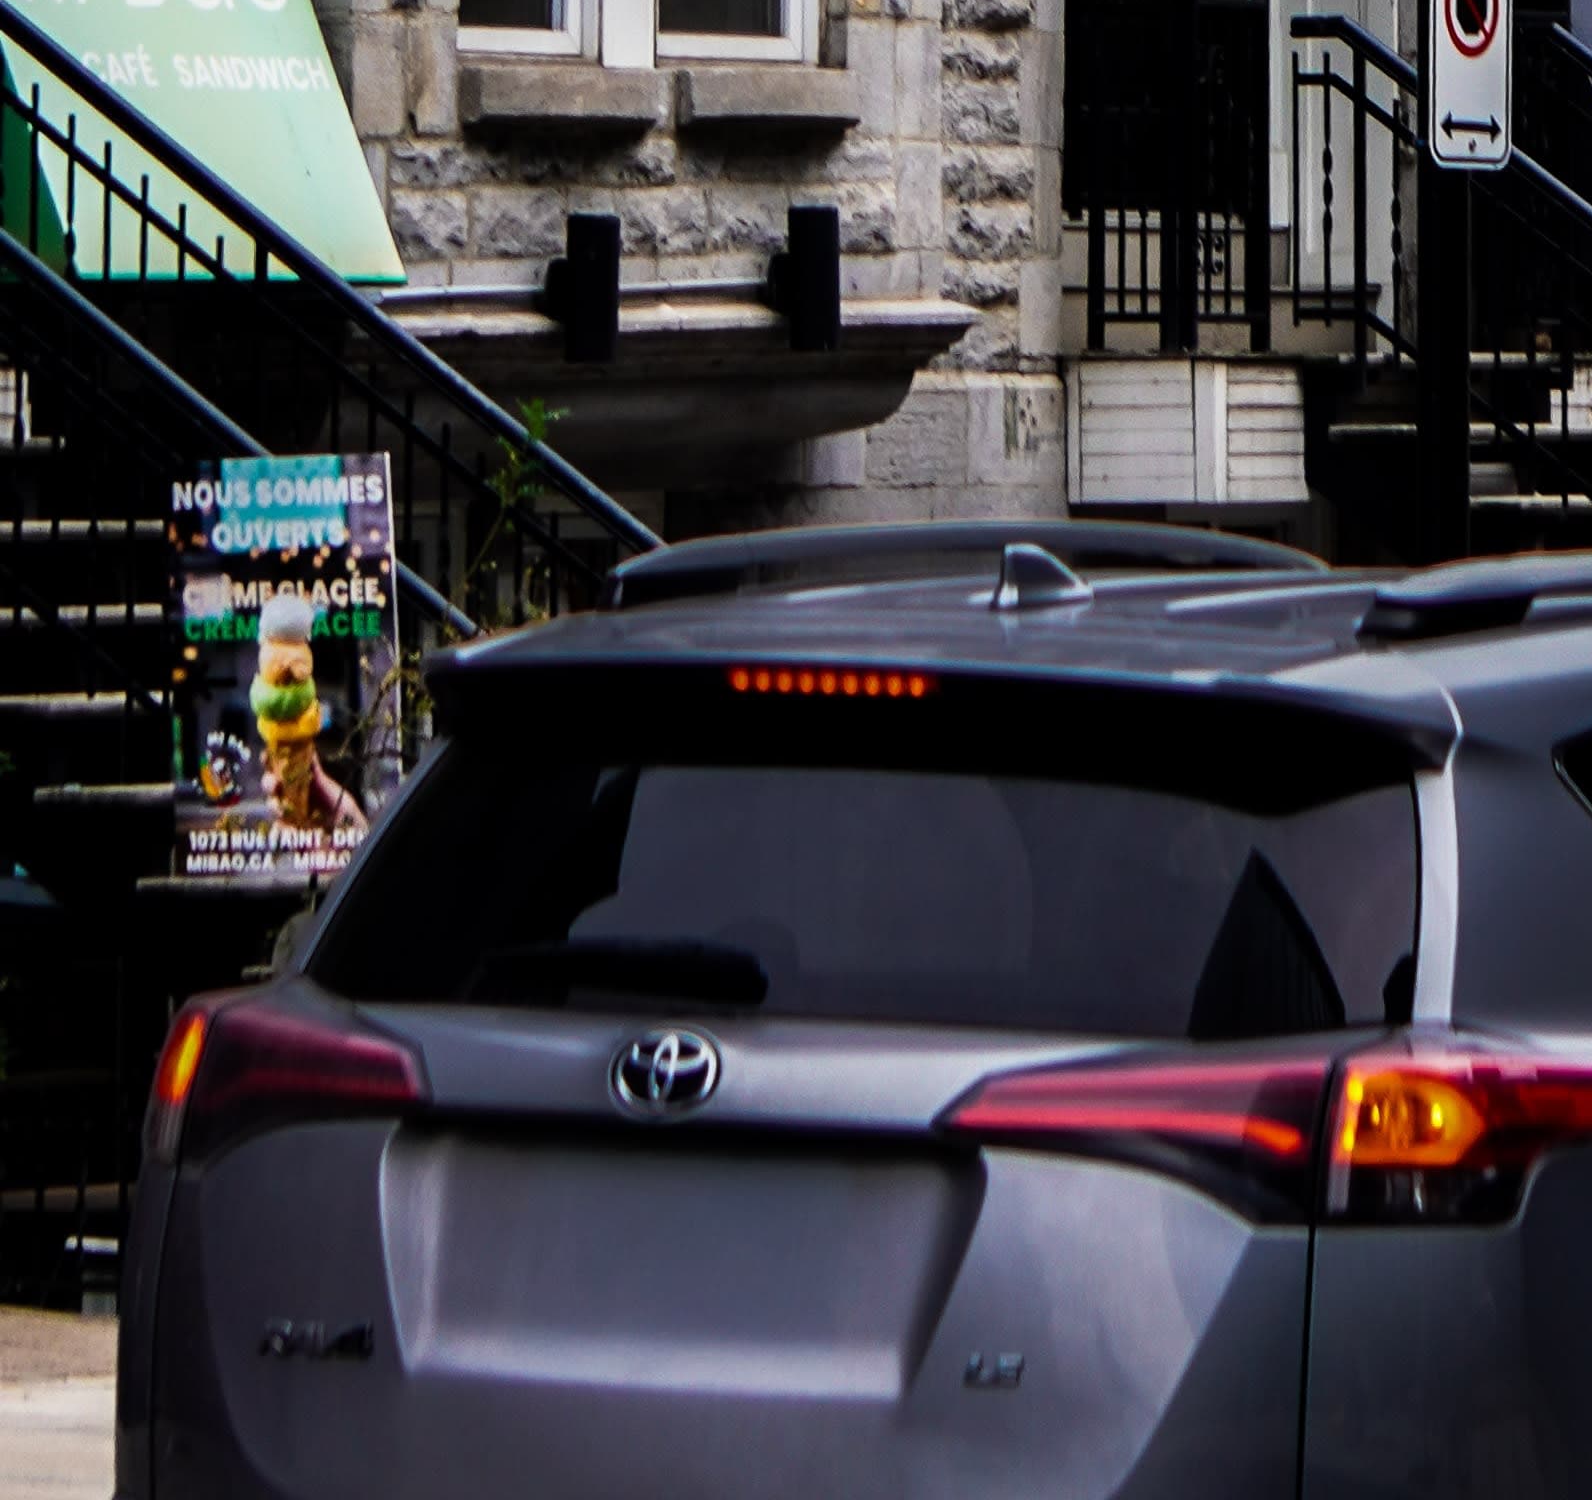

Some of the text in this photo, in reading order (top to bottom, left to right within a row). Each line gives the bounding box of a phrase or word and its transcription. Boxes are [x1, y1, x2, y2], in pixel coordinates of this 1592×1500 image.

[81, 44, 330, 90] CAFÉ SANDWICH
[172, 474, 384, 511] NOUS SOMMES
[212, 518, 346, 553] OUVERTS
[184, 607, 259, 641] CRÈM
